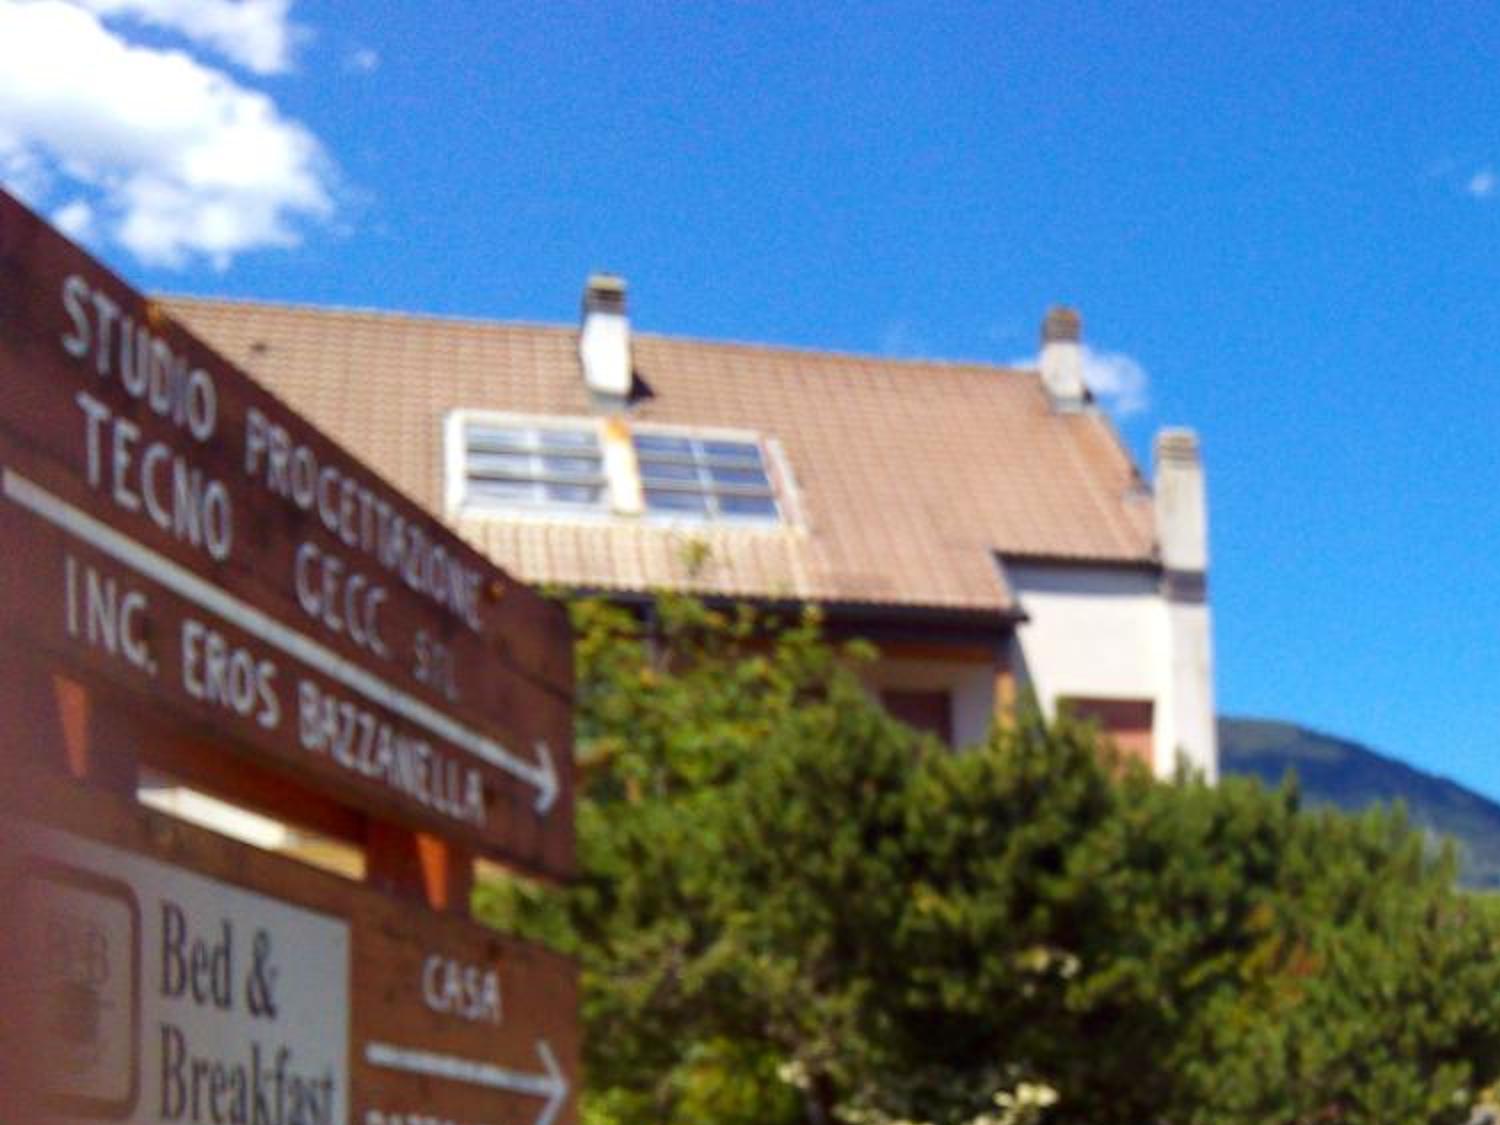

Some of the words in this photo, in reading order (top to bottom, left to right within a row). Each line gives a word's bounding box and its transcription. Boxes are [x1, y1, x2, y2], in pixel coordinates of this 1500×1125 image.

[61, 275, 217, 441] STUDIO
[76, 391, 232, 561] TECNO
[182, 619, 281, 728] EROS
[299, 680, 486, 826] BAZZANELLA
[161, 905, 231, 1007] Bed
[245, 931, 278, 1018] &
[423, 955, 502, 1025] CASA
